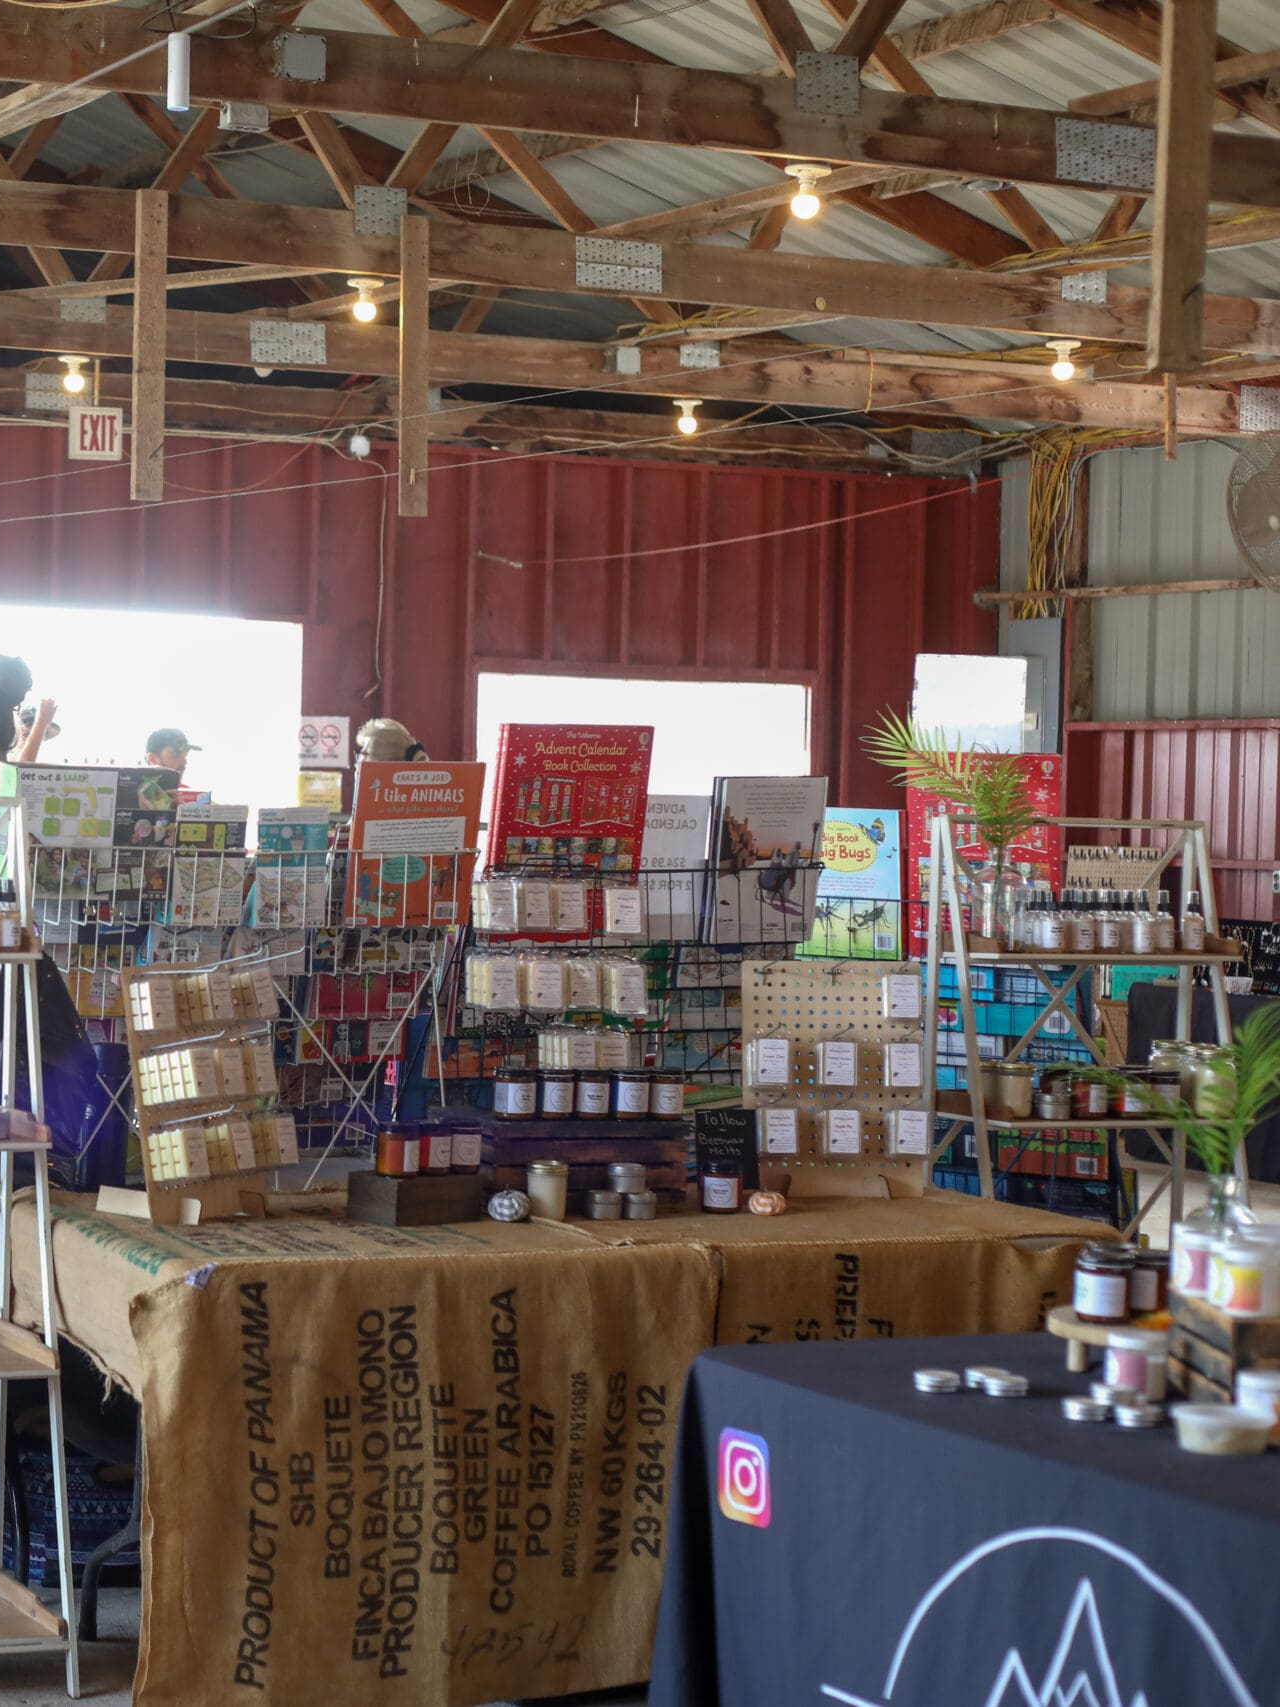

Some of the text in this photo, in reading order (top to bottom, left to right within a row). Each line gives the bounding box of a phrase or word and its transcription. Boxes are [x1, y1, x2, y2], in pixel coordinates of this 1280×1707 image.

[80, 414, 117, 452] EXIT
[21, 773, 35, 782] Get
[532, 741, 628, 757] Advent Calendar
[543, 760, 617, 772] Book Collection
[374, 788, 465, 803] I Like ANIMALS
[396, 774, 420, 782] THAT'S
[837, 833, 859, 842] Book
[839, 845, 871, 862] Bugs
[429, 1382, 460, 1574] BOQUETE
[463, 1408, 489, 1543] GREEN
[489, 1288, 521, 1614] COFFEE ARABICA
[568, 1447, 585, 1468] NY
[631, 1384, 667, 1559] 29-264-02
[234, 1281, 280, 1690] PRODUCT OF PANAMA
[288, 1451, 316, 1528] SHB
[324, 1395, 354, 1579] BOQUETE
[351, 1308, 390, 1661] FINCA BAJO MONO
[379, 1305, 424, 1680] PRODUCER REGION
[525, 1404, 555, 1556] PO 15127
[564, 1470, 584, 1527] COFFEE
[562, 1533, 578, 1578] ROYAL
